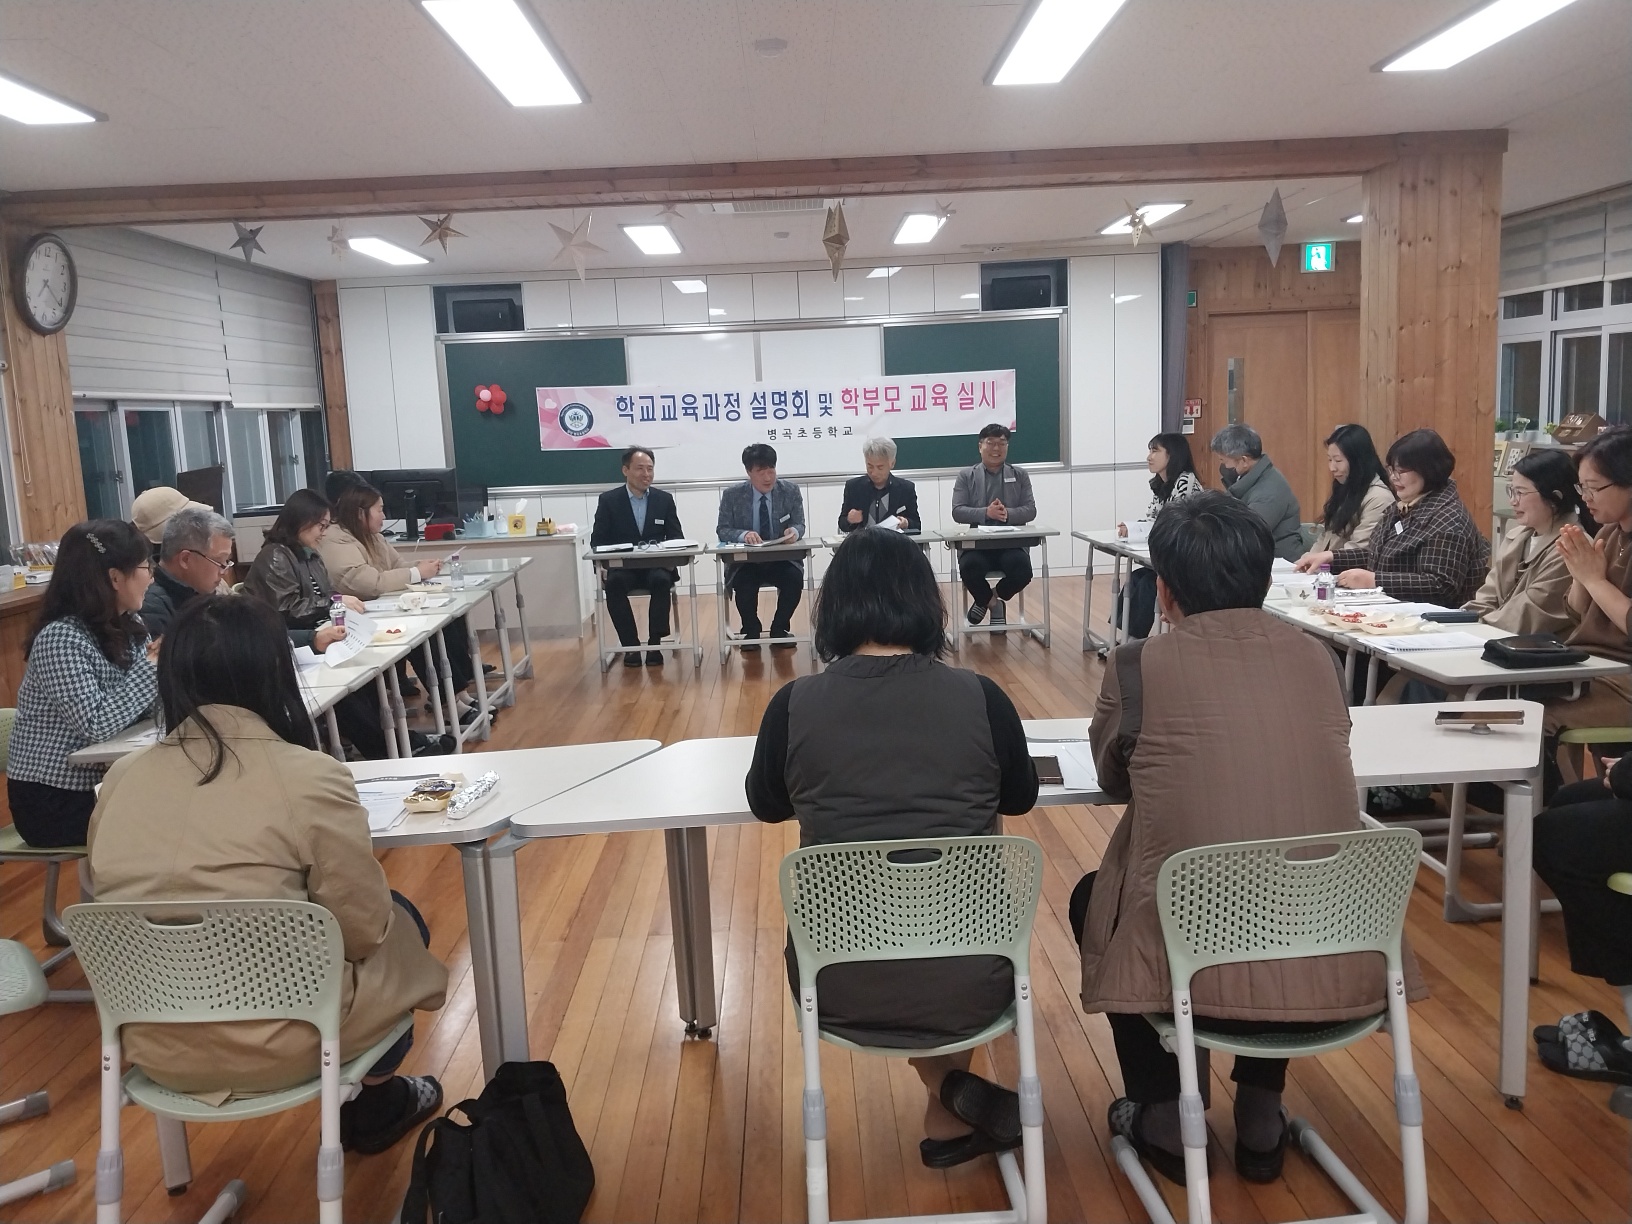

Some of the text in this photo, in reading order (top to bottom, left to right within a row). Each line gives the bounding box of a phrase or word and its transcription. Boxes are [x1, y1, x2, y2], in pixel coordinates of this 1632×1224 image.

[44, 246, 51, 258] 12
[60, 265, 65, 276] 2
[61, 282, 67, 293] 3
[616, 391, 741, 425] 학교교육과정
[749, 389, 810, 420] 설명회
[818, 392, 834, 418] 및
[841, 386, 902, 417] 학부모
[910, 383, 949, 412] 교육
[957, 380, 997, 411] 실시
[767, 426, 853, 441] 병곡초등학교
